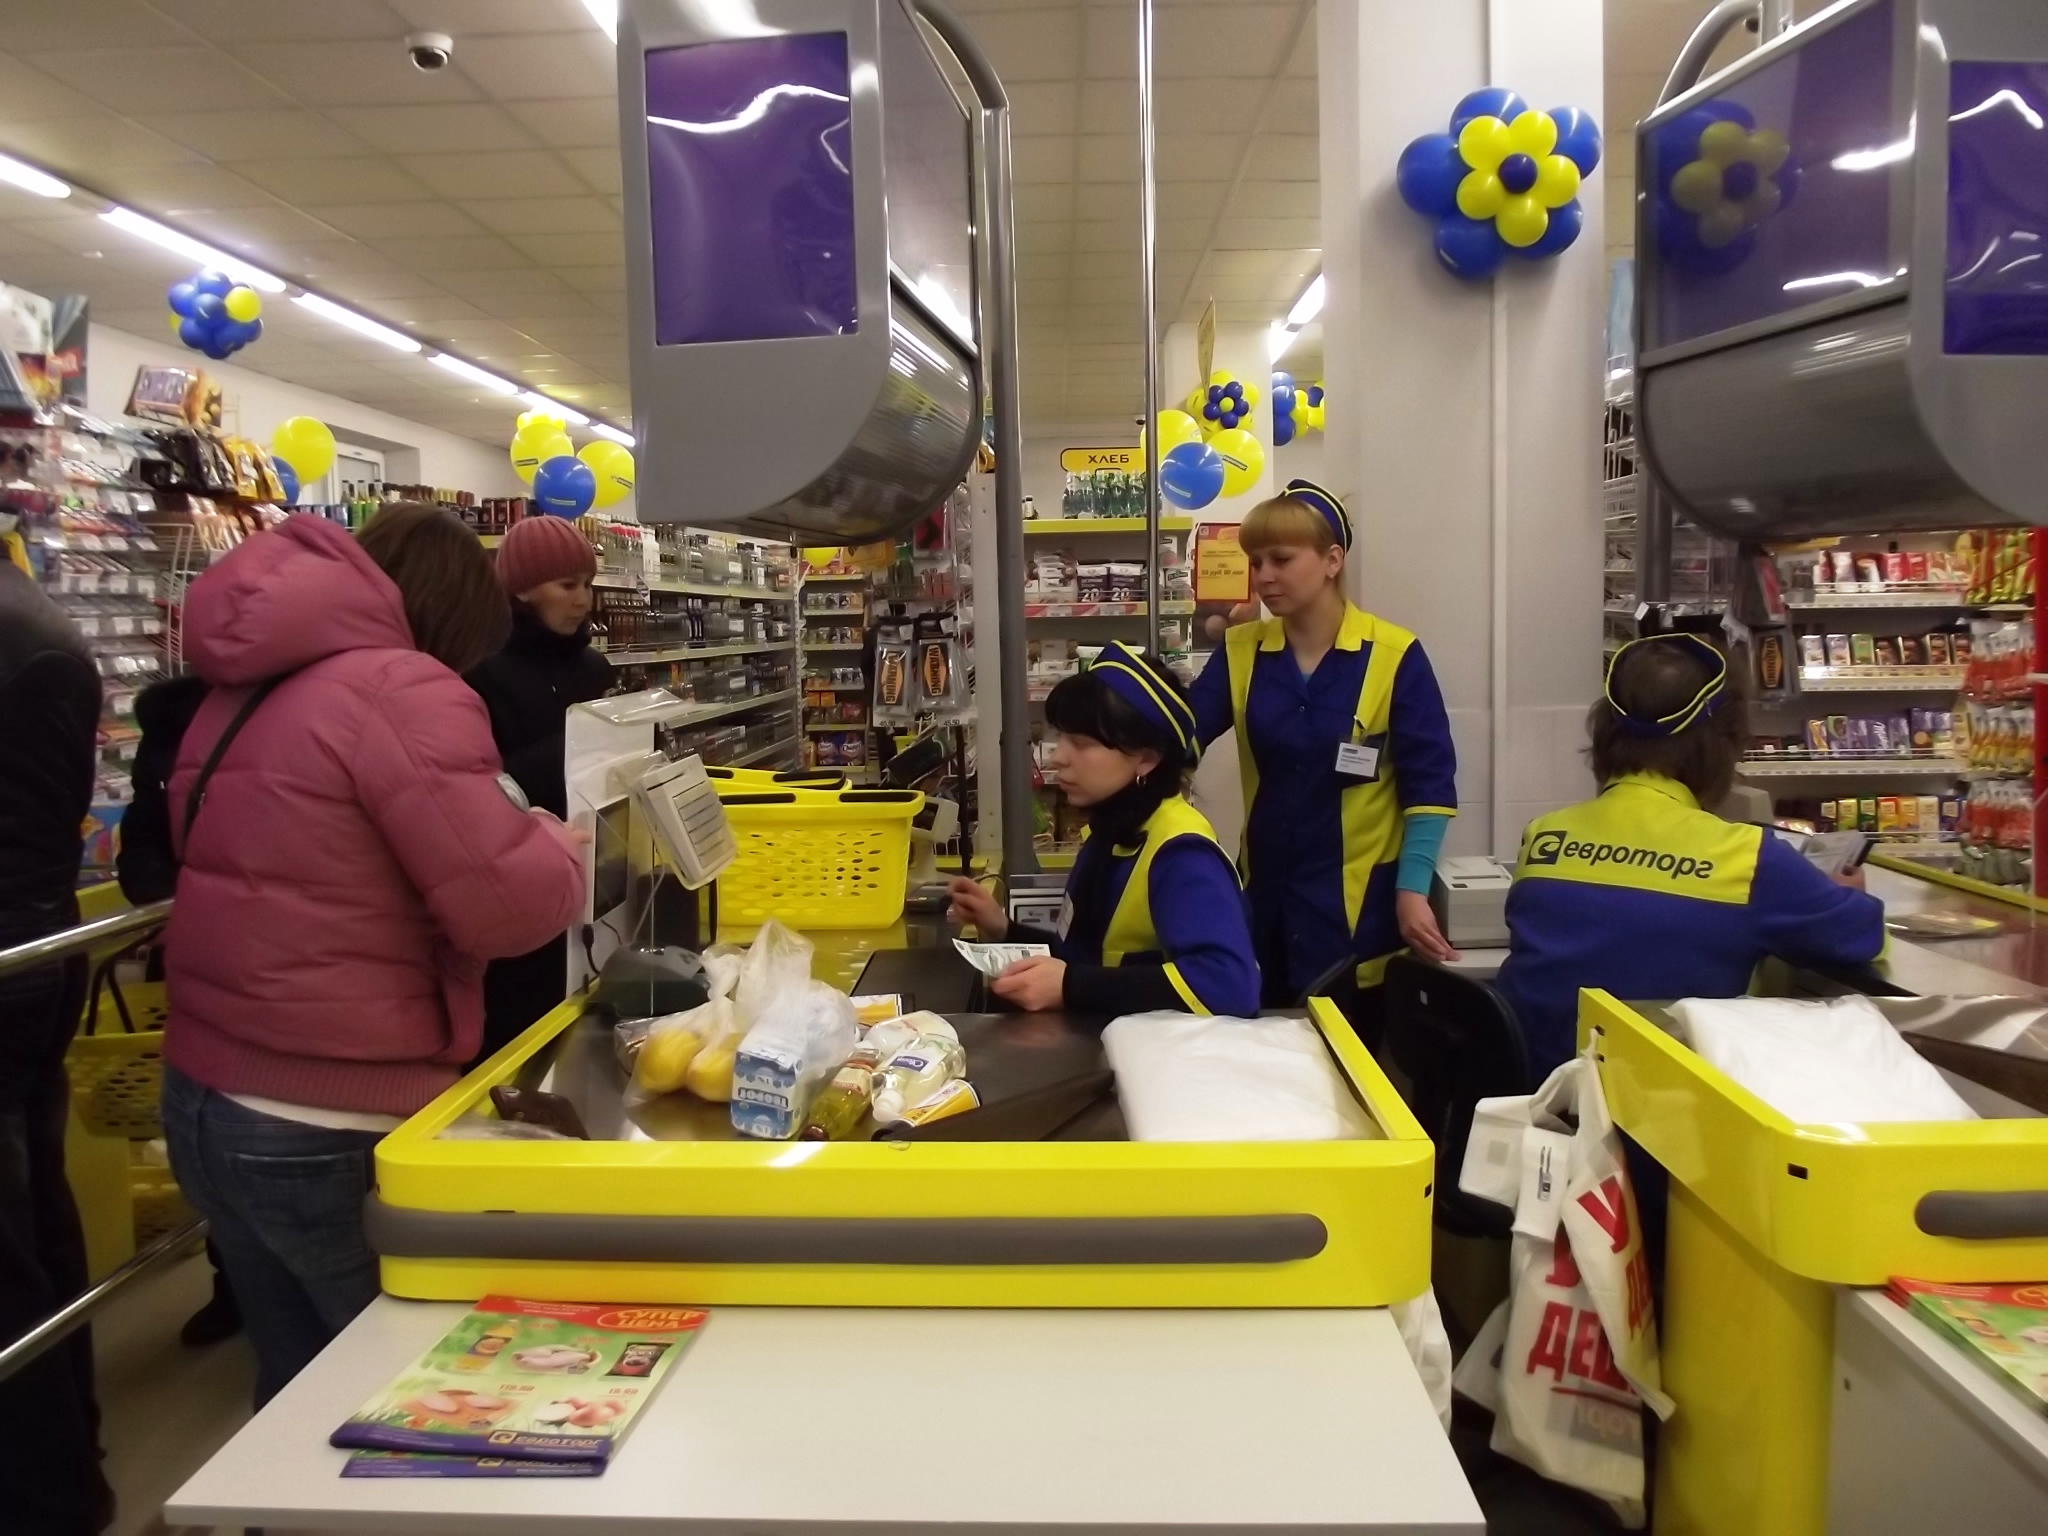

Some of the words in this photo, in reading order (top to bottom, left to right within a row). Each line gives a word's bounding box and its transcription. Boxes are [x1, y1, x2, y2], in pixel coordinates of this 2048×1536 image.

[1087, 453, 1130, 464] ХЛЕБ
[886, 653, 899, 702] WARNING
[929, 646, 942, 695] WARNING
[1562, 840, 1714, 880] евроторг
[617, 1310, 700, 1321] СУПЕР
[617, 1319, 680, 1329] ЦЕНА
